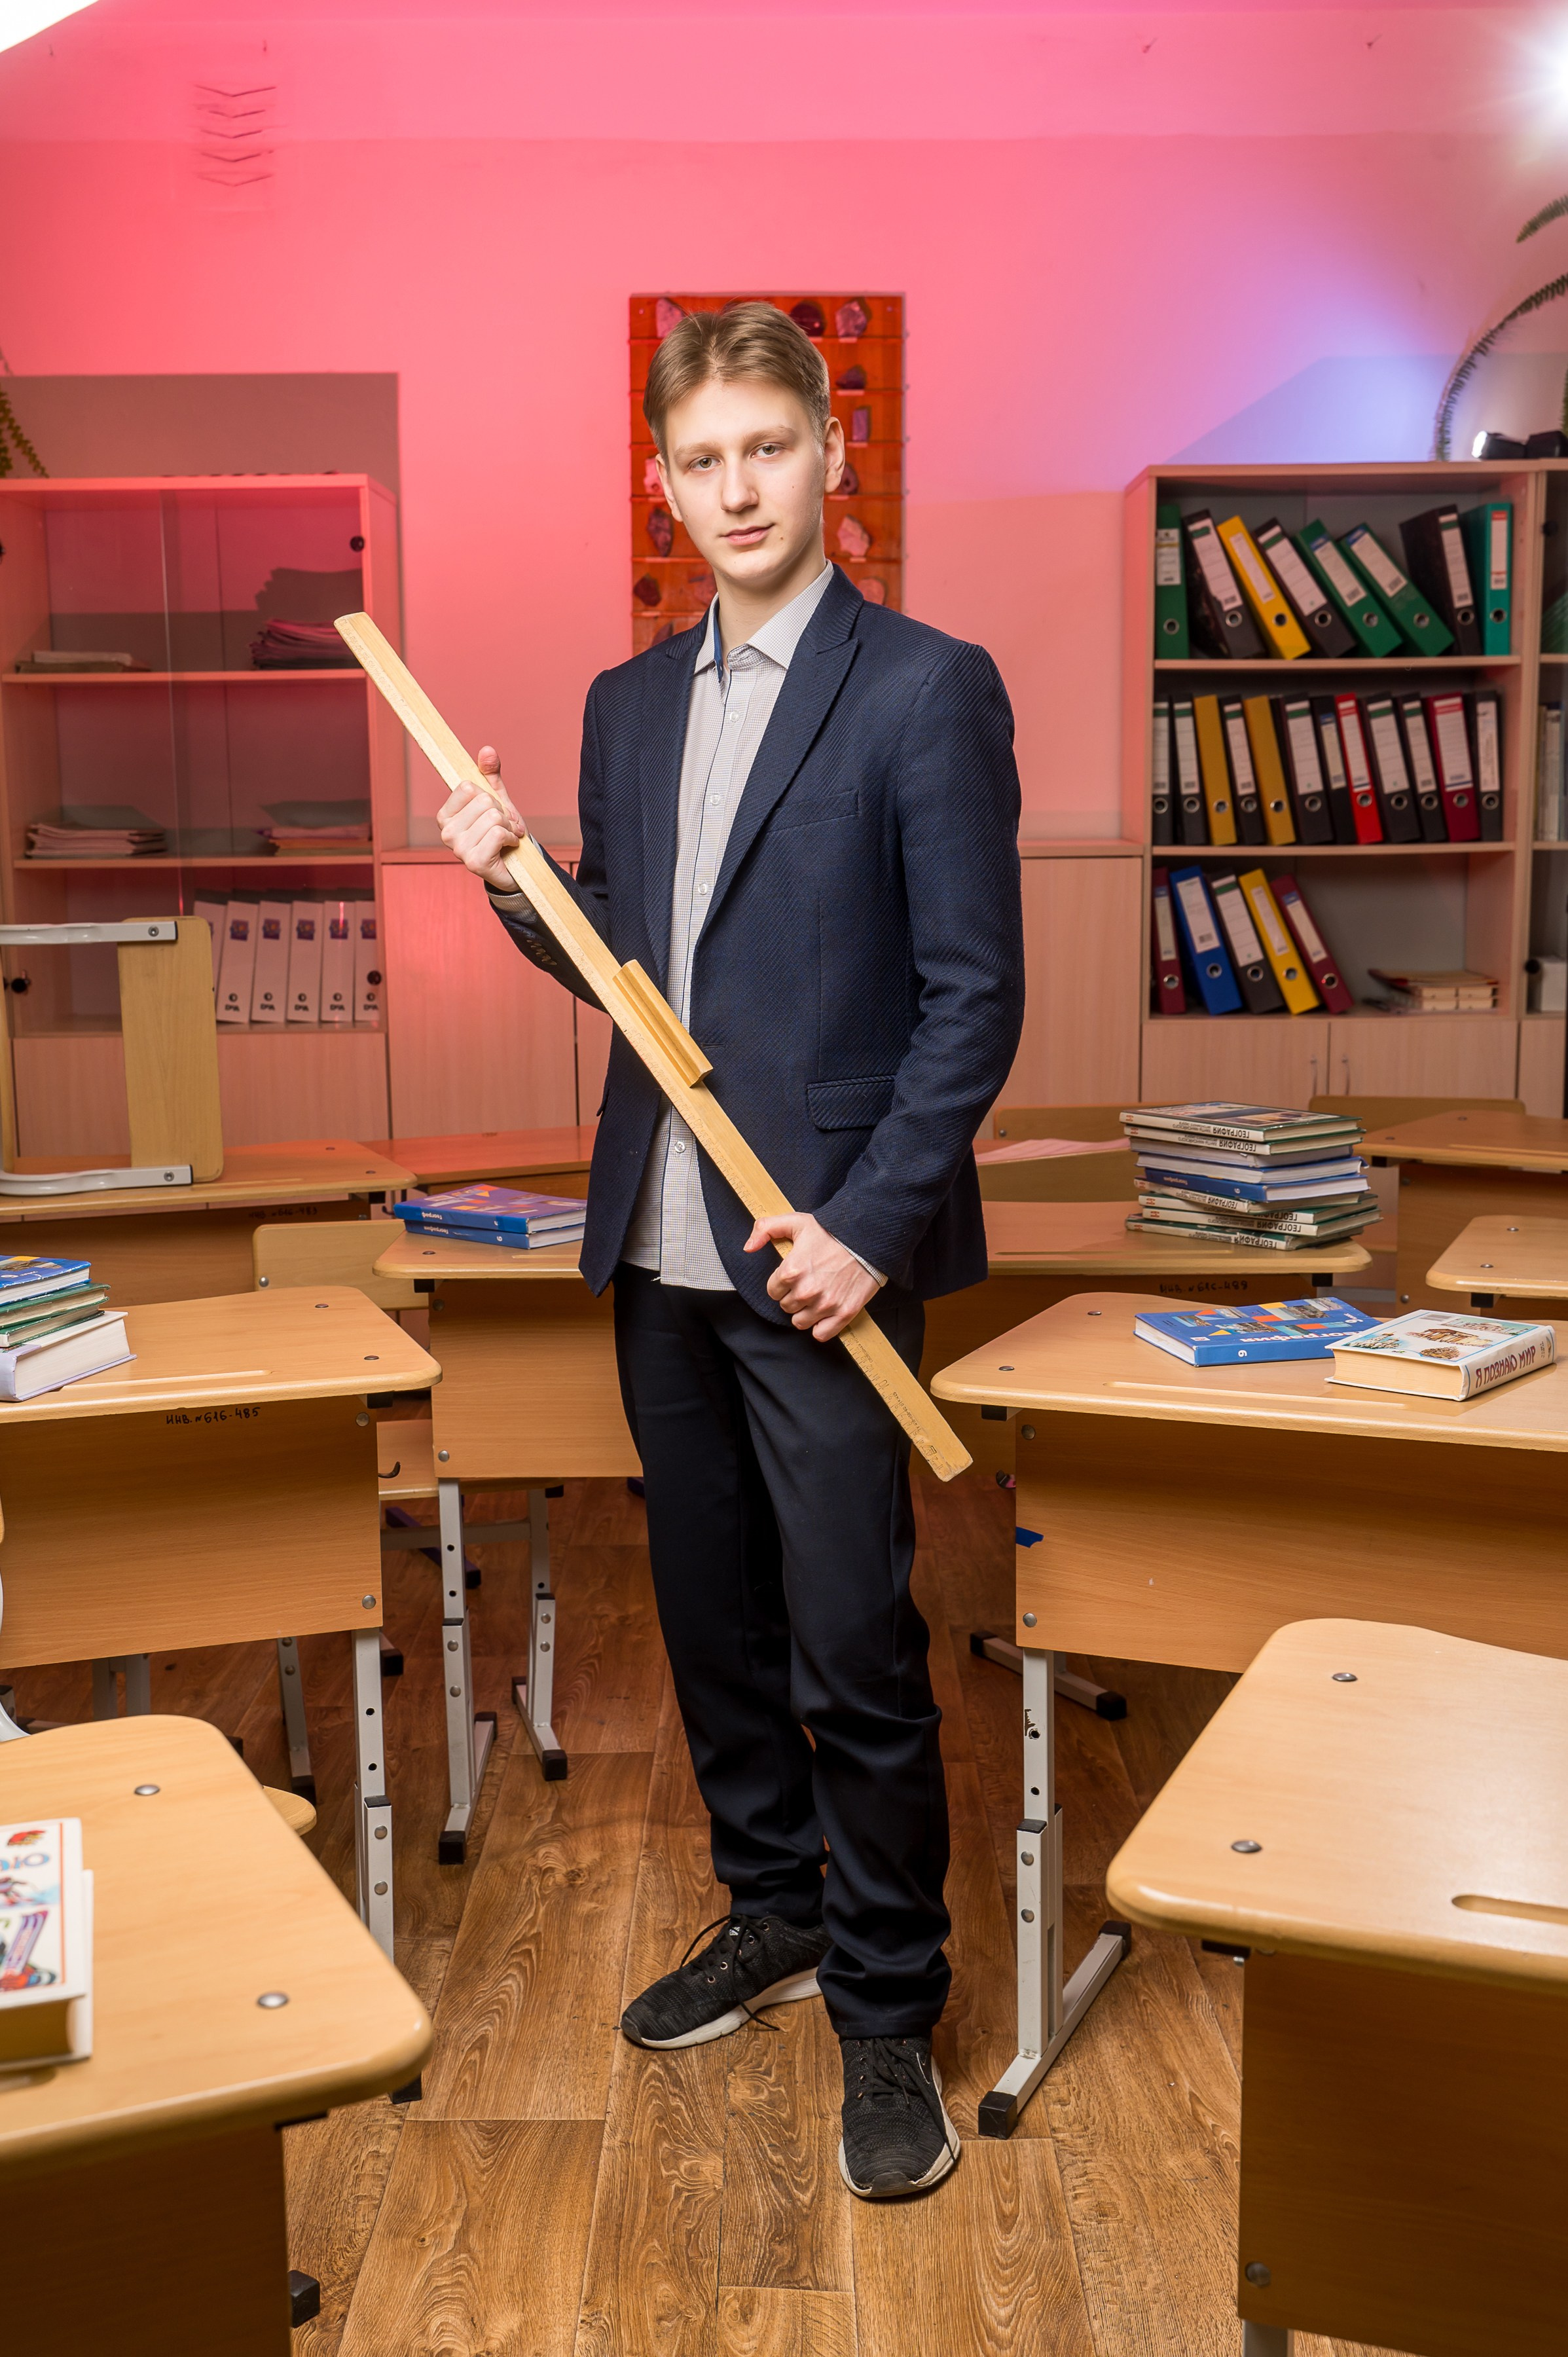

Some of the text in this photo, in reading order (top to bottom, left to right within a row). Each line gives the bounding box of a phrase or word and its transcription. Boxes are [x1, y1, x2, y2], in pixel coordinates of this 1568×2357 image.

[1212, 1125, 1250, 1139] ГЕОГРАФИЯ
[1218, 1139, 1256, 1152] ГЕОГРАФИЯ
[1207, 1196, 1237, 1209] ГЕОГРАФИЯ
[1256, 1218, 1302, 1234] ГЕОГРАФИЯ
[1233, 1233, 1277, 1249] ГЕОГРАФИЯ
[1239, 1330, 1362, 1342] еография
[1475, 1367, 1482, 1388] Я
[1484, 1355, 1518, 1385] ПОЗНАЮ
[1519, 1345, 1536, 1369] МИР
[166, 1414, 192, 1425] ИНВ.
